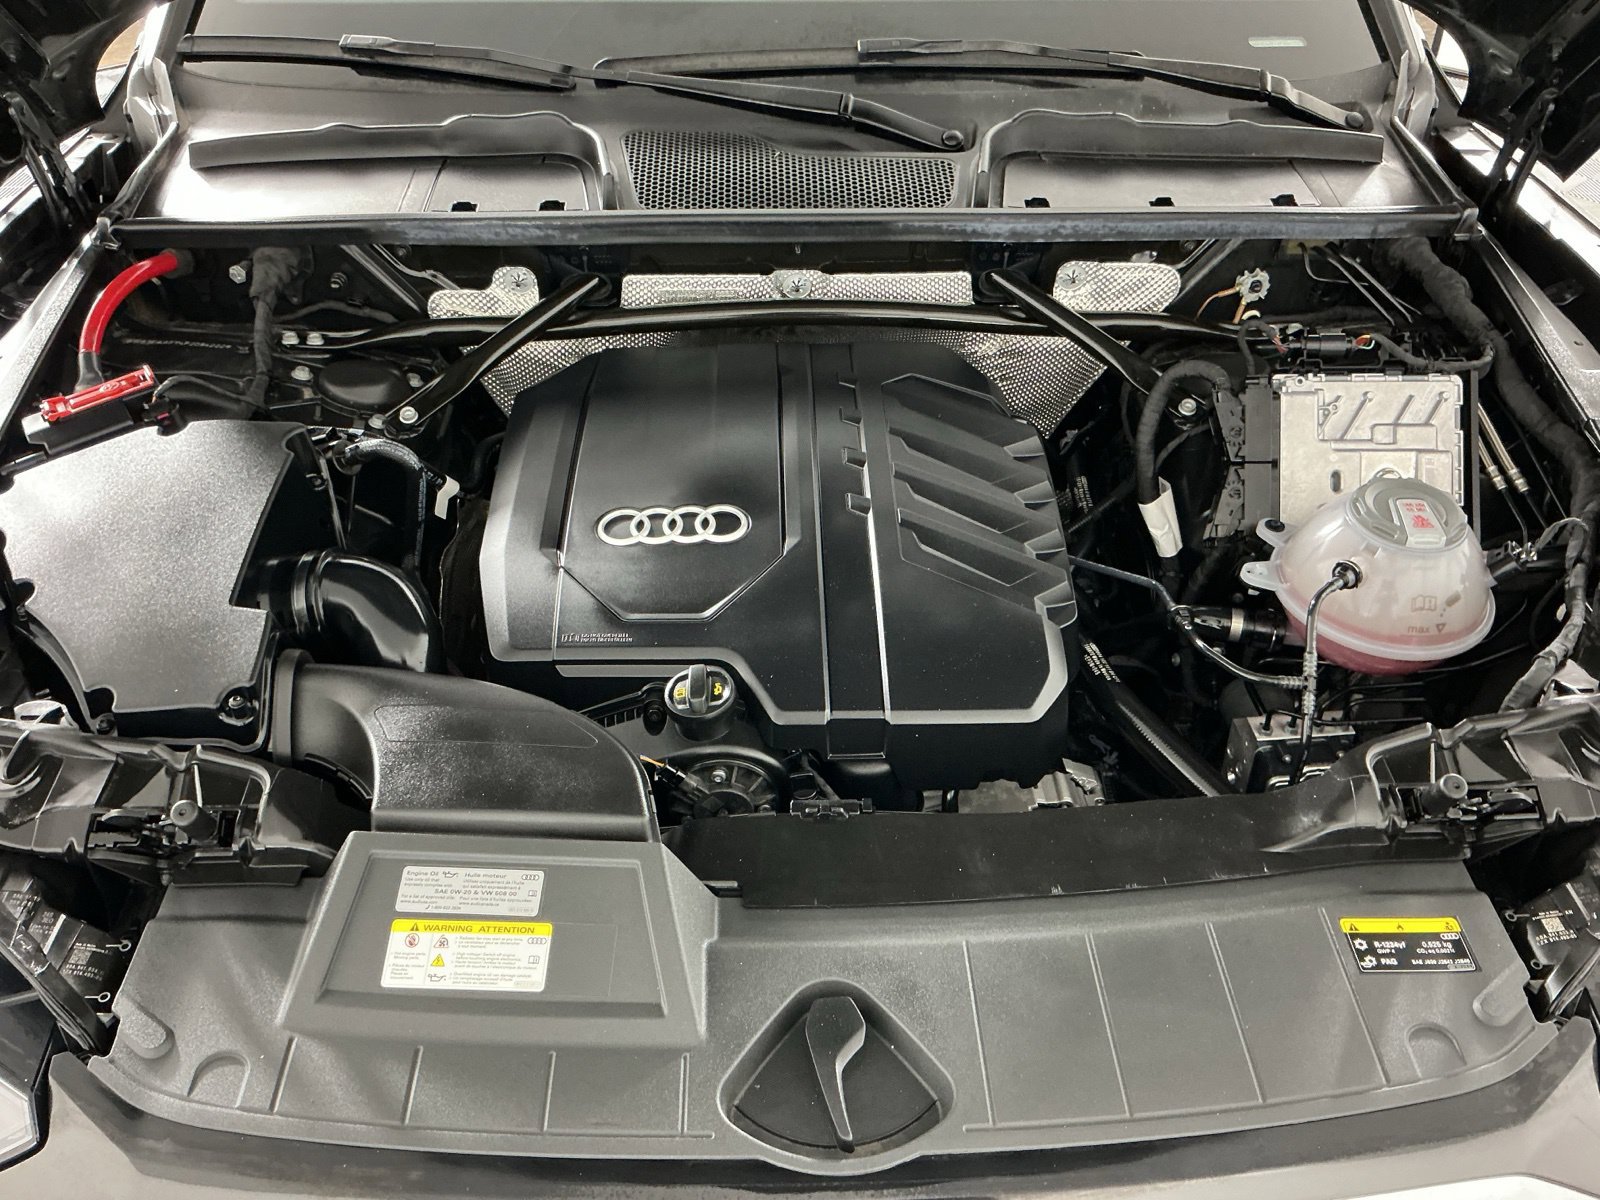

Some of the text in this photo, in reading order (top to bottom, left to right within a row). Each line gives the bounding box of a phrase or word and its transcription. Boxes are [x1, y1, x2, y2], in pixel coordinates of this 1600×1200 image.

[424, 924, 534, 934] WARNING ATTENTION
[1373, 941, 1406, 949] R-1234yf
[1442, 941, 1452, 949] kg
